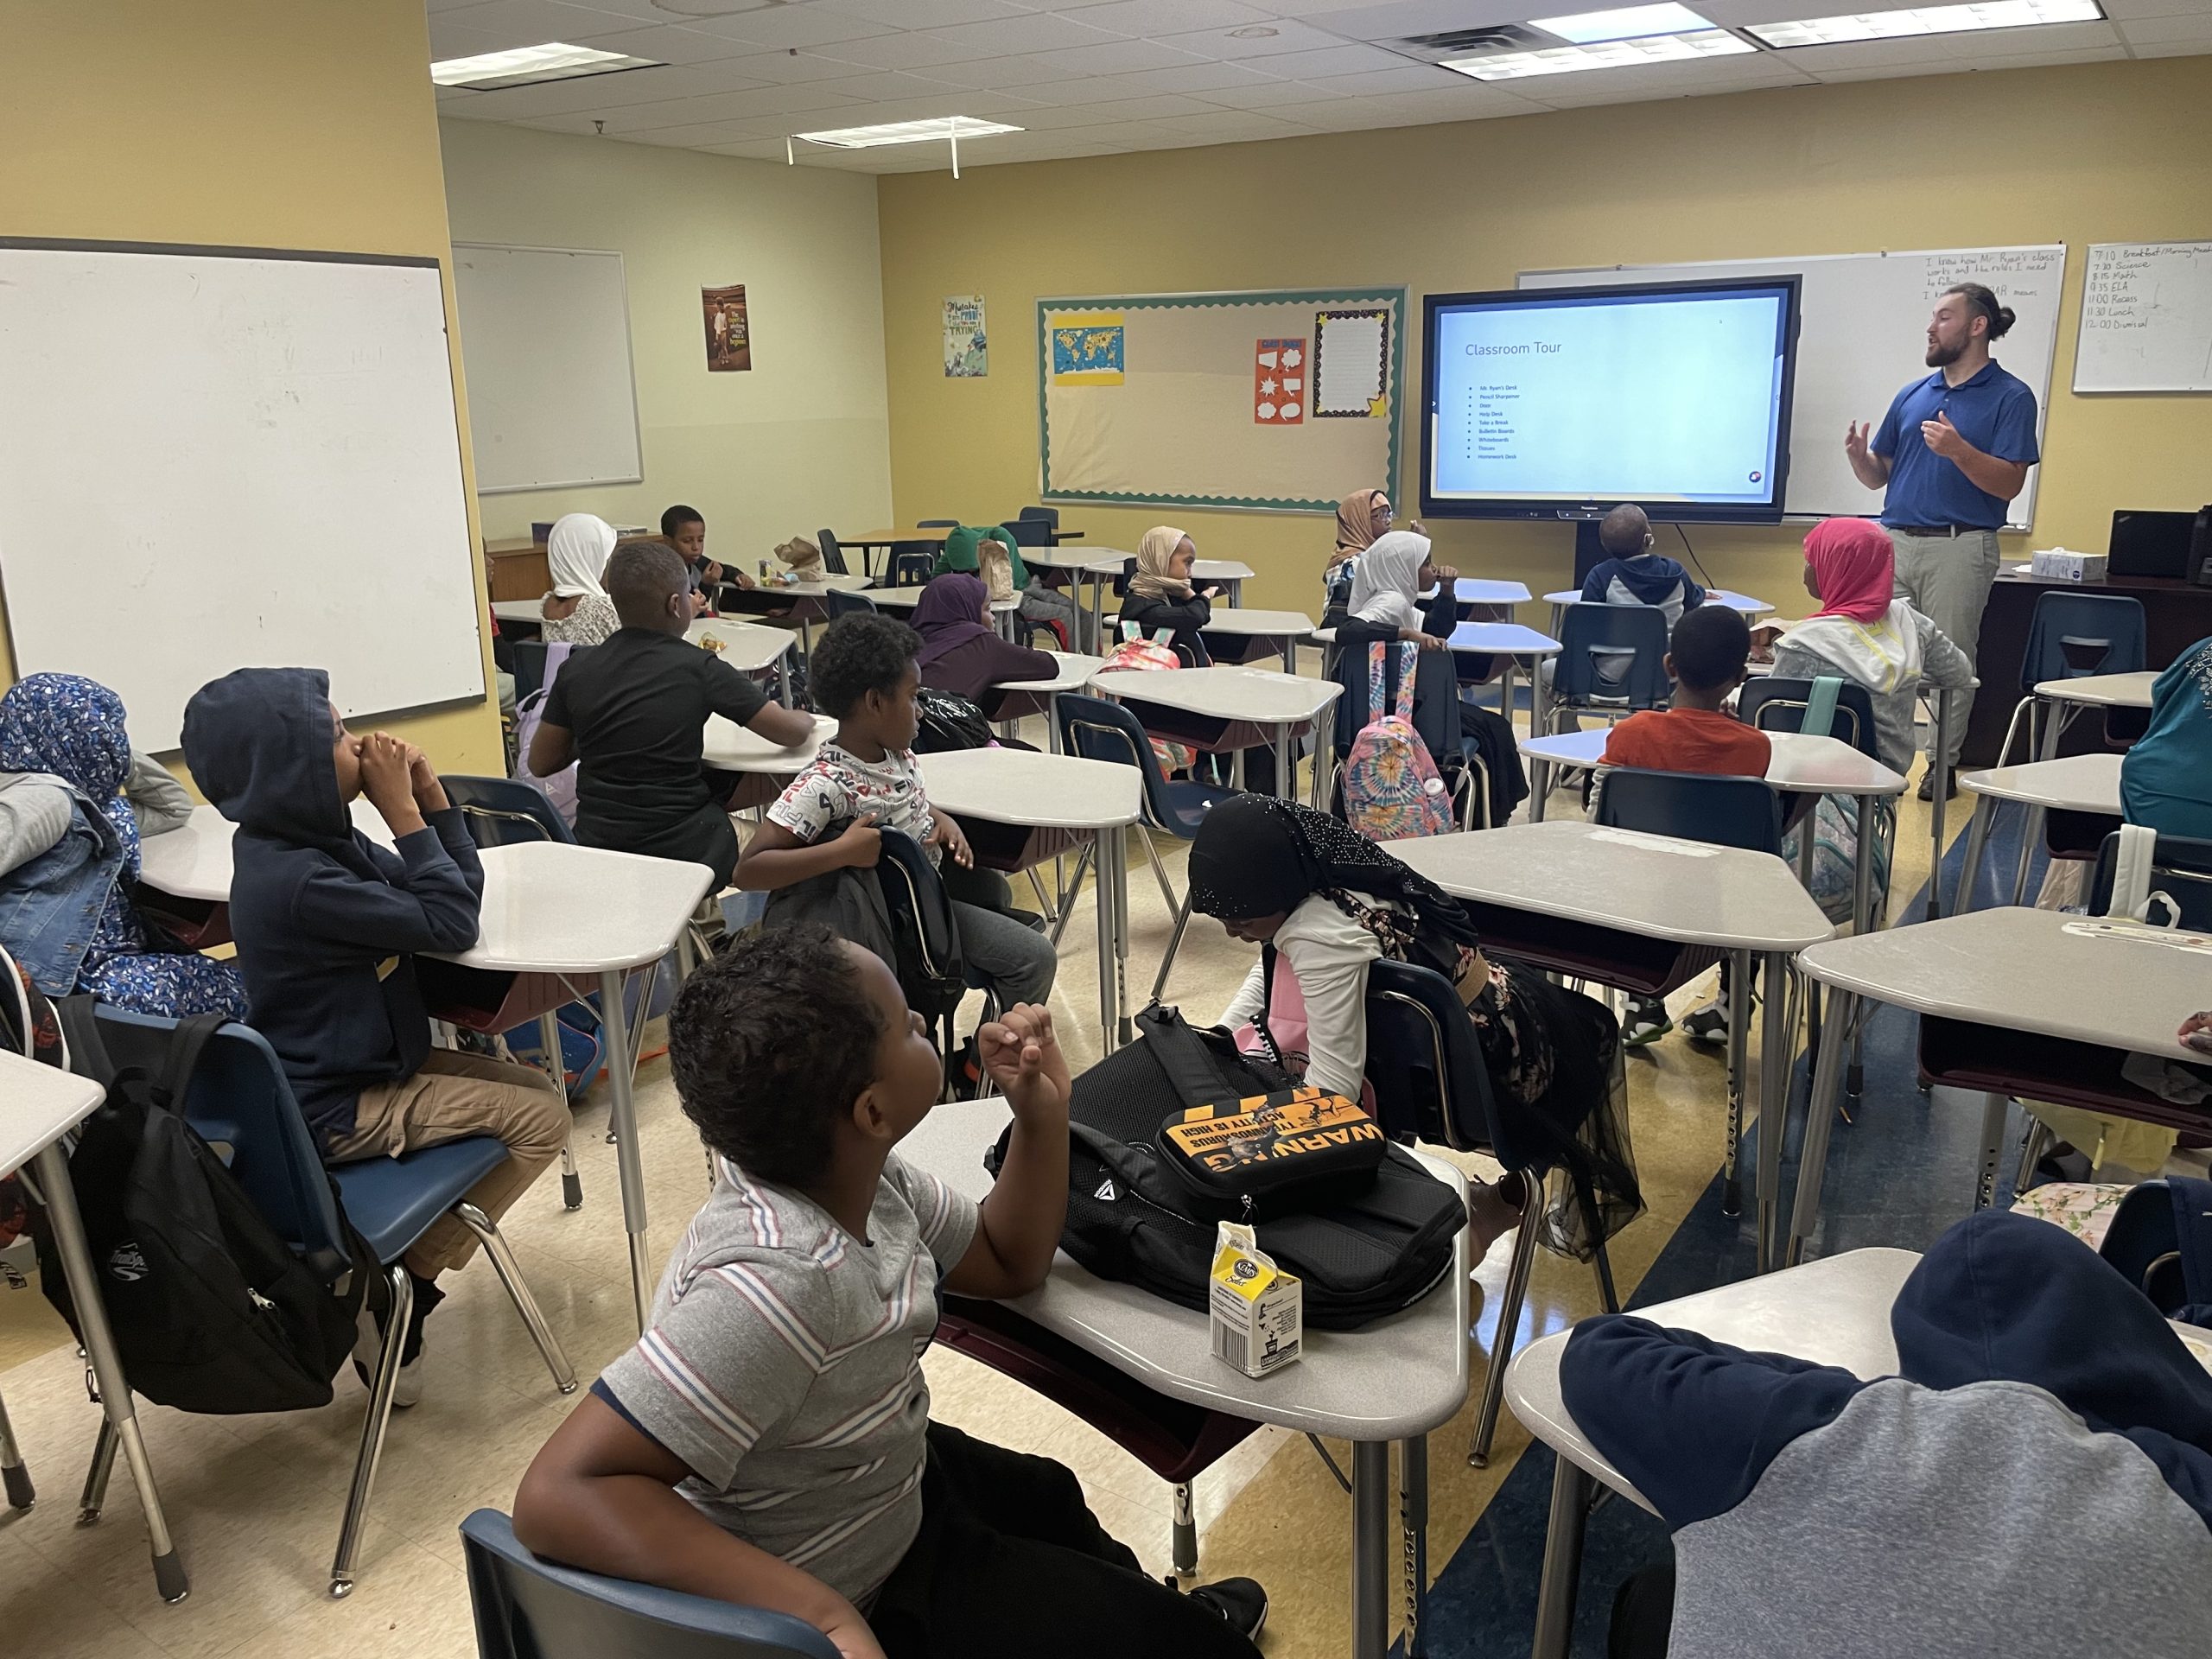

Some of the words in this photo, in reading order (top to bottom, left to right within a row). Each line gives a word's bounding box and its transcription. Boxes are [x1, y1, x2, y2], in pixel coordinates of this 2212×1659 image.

[2115, 261, 2151, 270] Science
[2113, 270, 2138, 280] Math
[2111, 281, 2128, 292] ELA
[2111, 294, 2138, 304] Recess
[2108, 306, 2135, 316] Lunch
[1465, 344, 1530, 356] Classroom
[1533, 341, 1562, 353] Tour
[1180, 1124, 1214, 1138] HIGH
[1214, 1122, 1230, 1132] IS
[1204, 1123, 1385, 1173] WARNG
